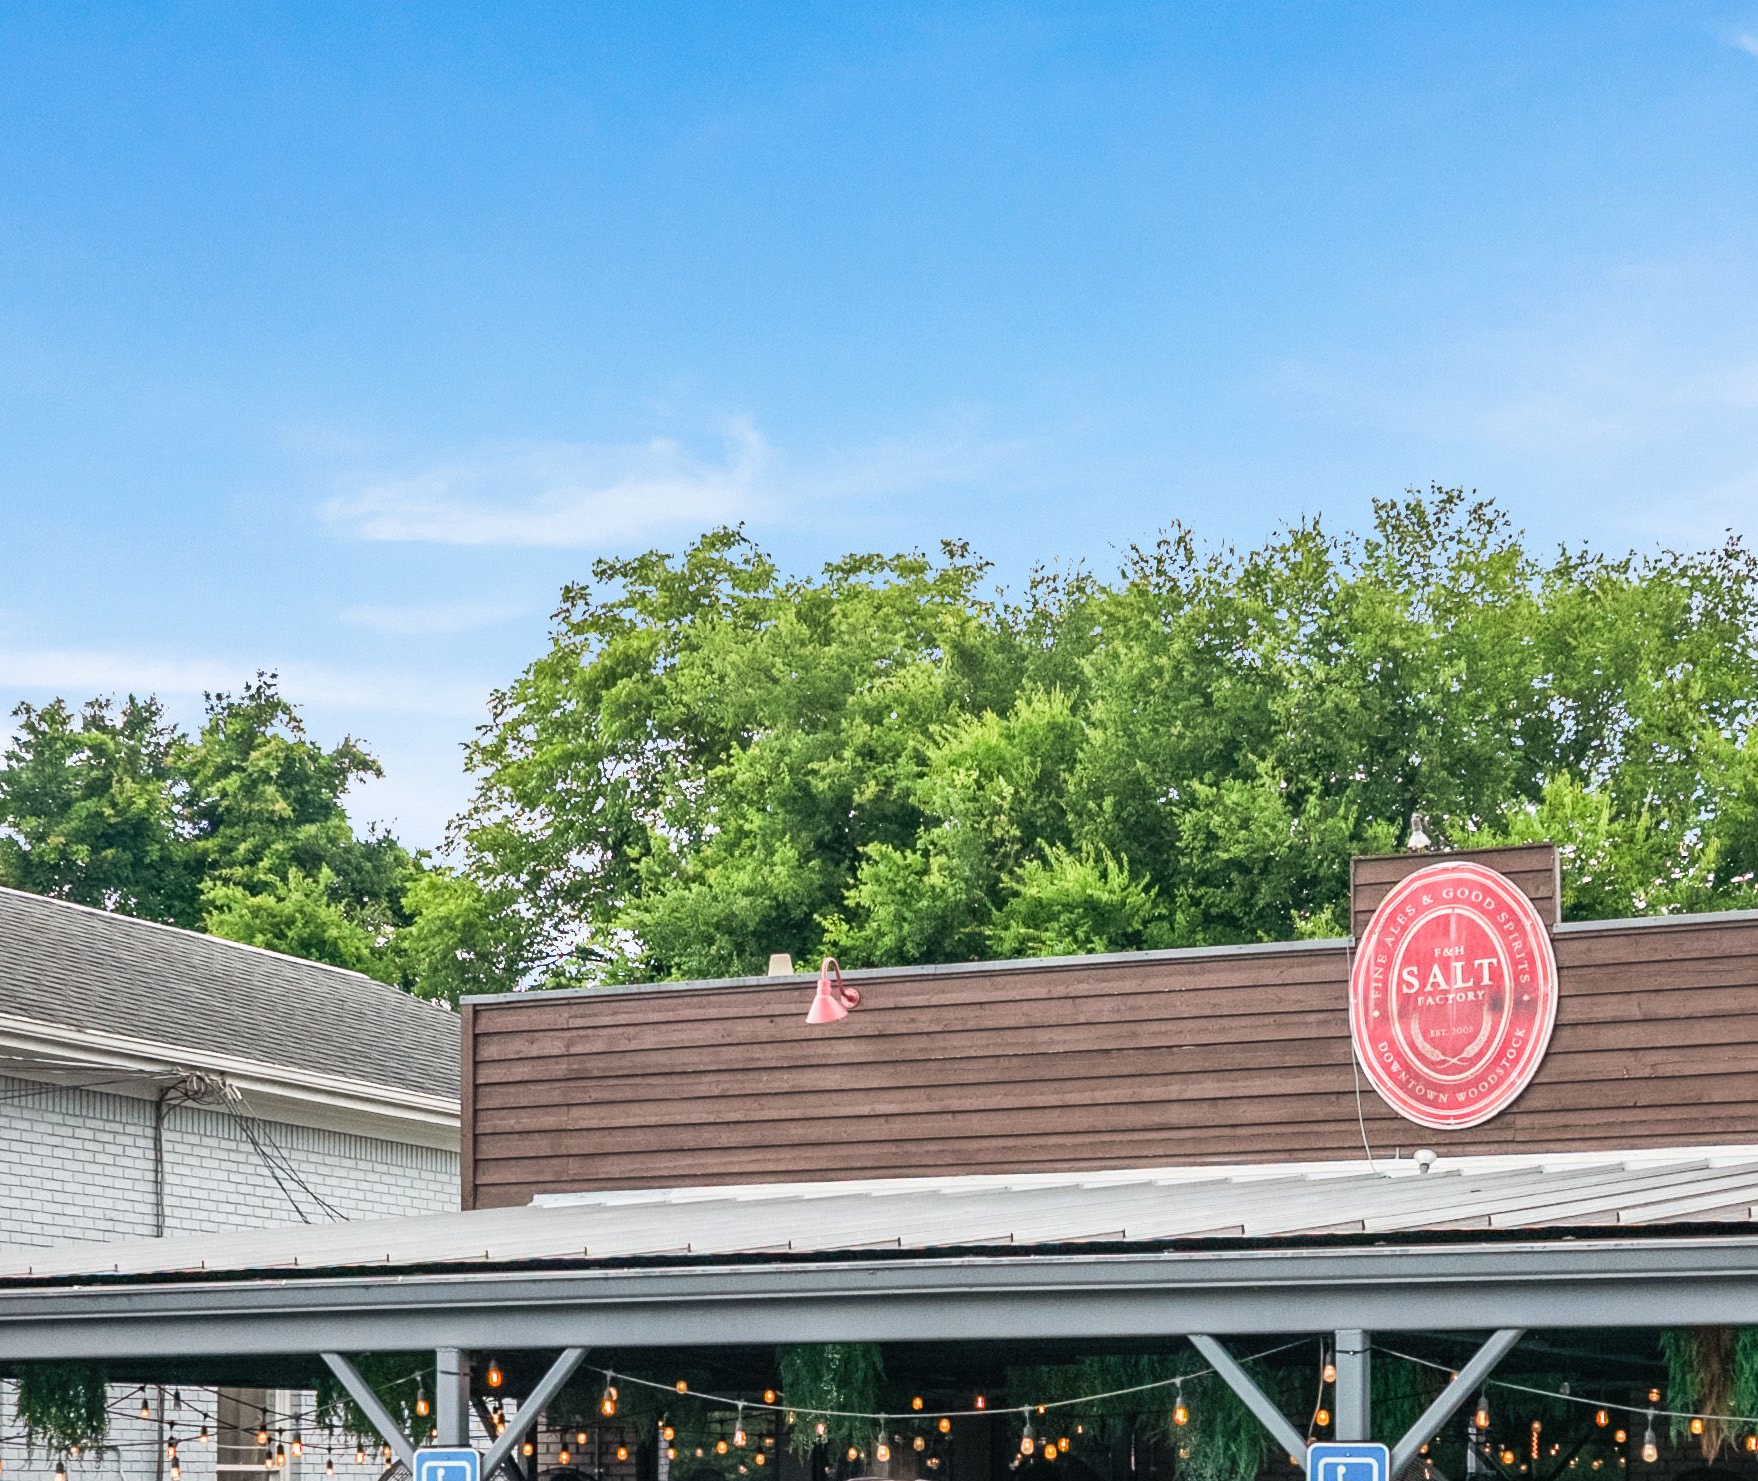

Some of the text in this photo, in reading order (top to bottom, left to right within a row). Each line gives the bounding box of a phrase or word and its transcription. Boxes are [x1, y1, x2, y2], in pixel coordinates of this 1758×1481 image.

[1372, 888, 1531, 999] FINE ALES & GOOD SPIRITS
[1434, 945, 1465, 958] F&H
[1401, 958, 1497, 994] SALT
[1417, 990, 1486, 1006] FACTORY
[1378, 1028, 1526, 1103] DOWNTOWN WOODSTOCK
